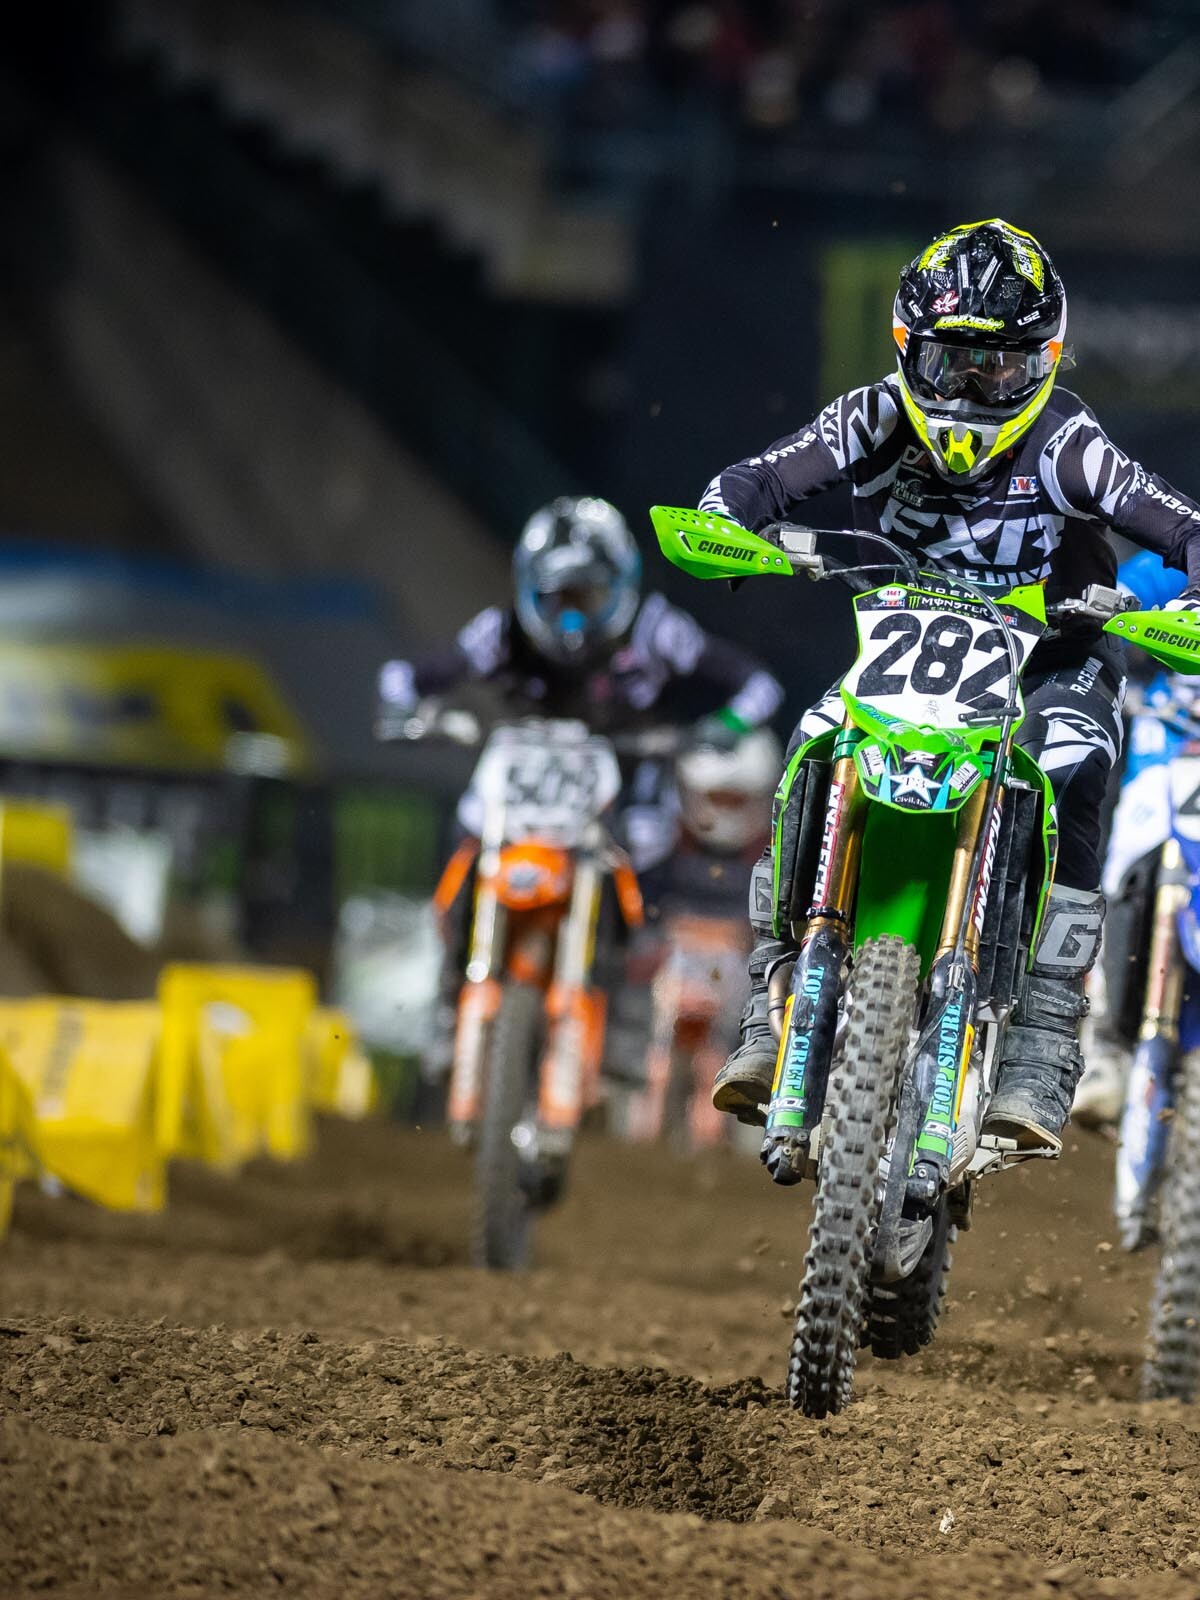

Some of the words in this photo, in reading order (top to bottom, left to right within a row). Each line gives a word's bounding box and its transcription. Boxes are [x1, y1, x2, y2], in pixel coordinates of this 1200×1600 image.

[1016, 310, 1041, 326] LS2
[698, 539, 758, 562] CIRCUIT
[921, 597, 988, 617] MONSTER
[930, 606, 980, 619] ENERGY
[856, 613, 1024, 711] 282
[936, 994, 962, 1075] SECRE
[931, 1075, 954, 1114] TOP
